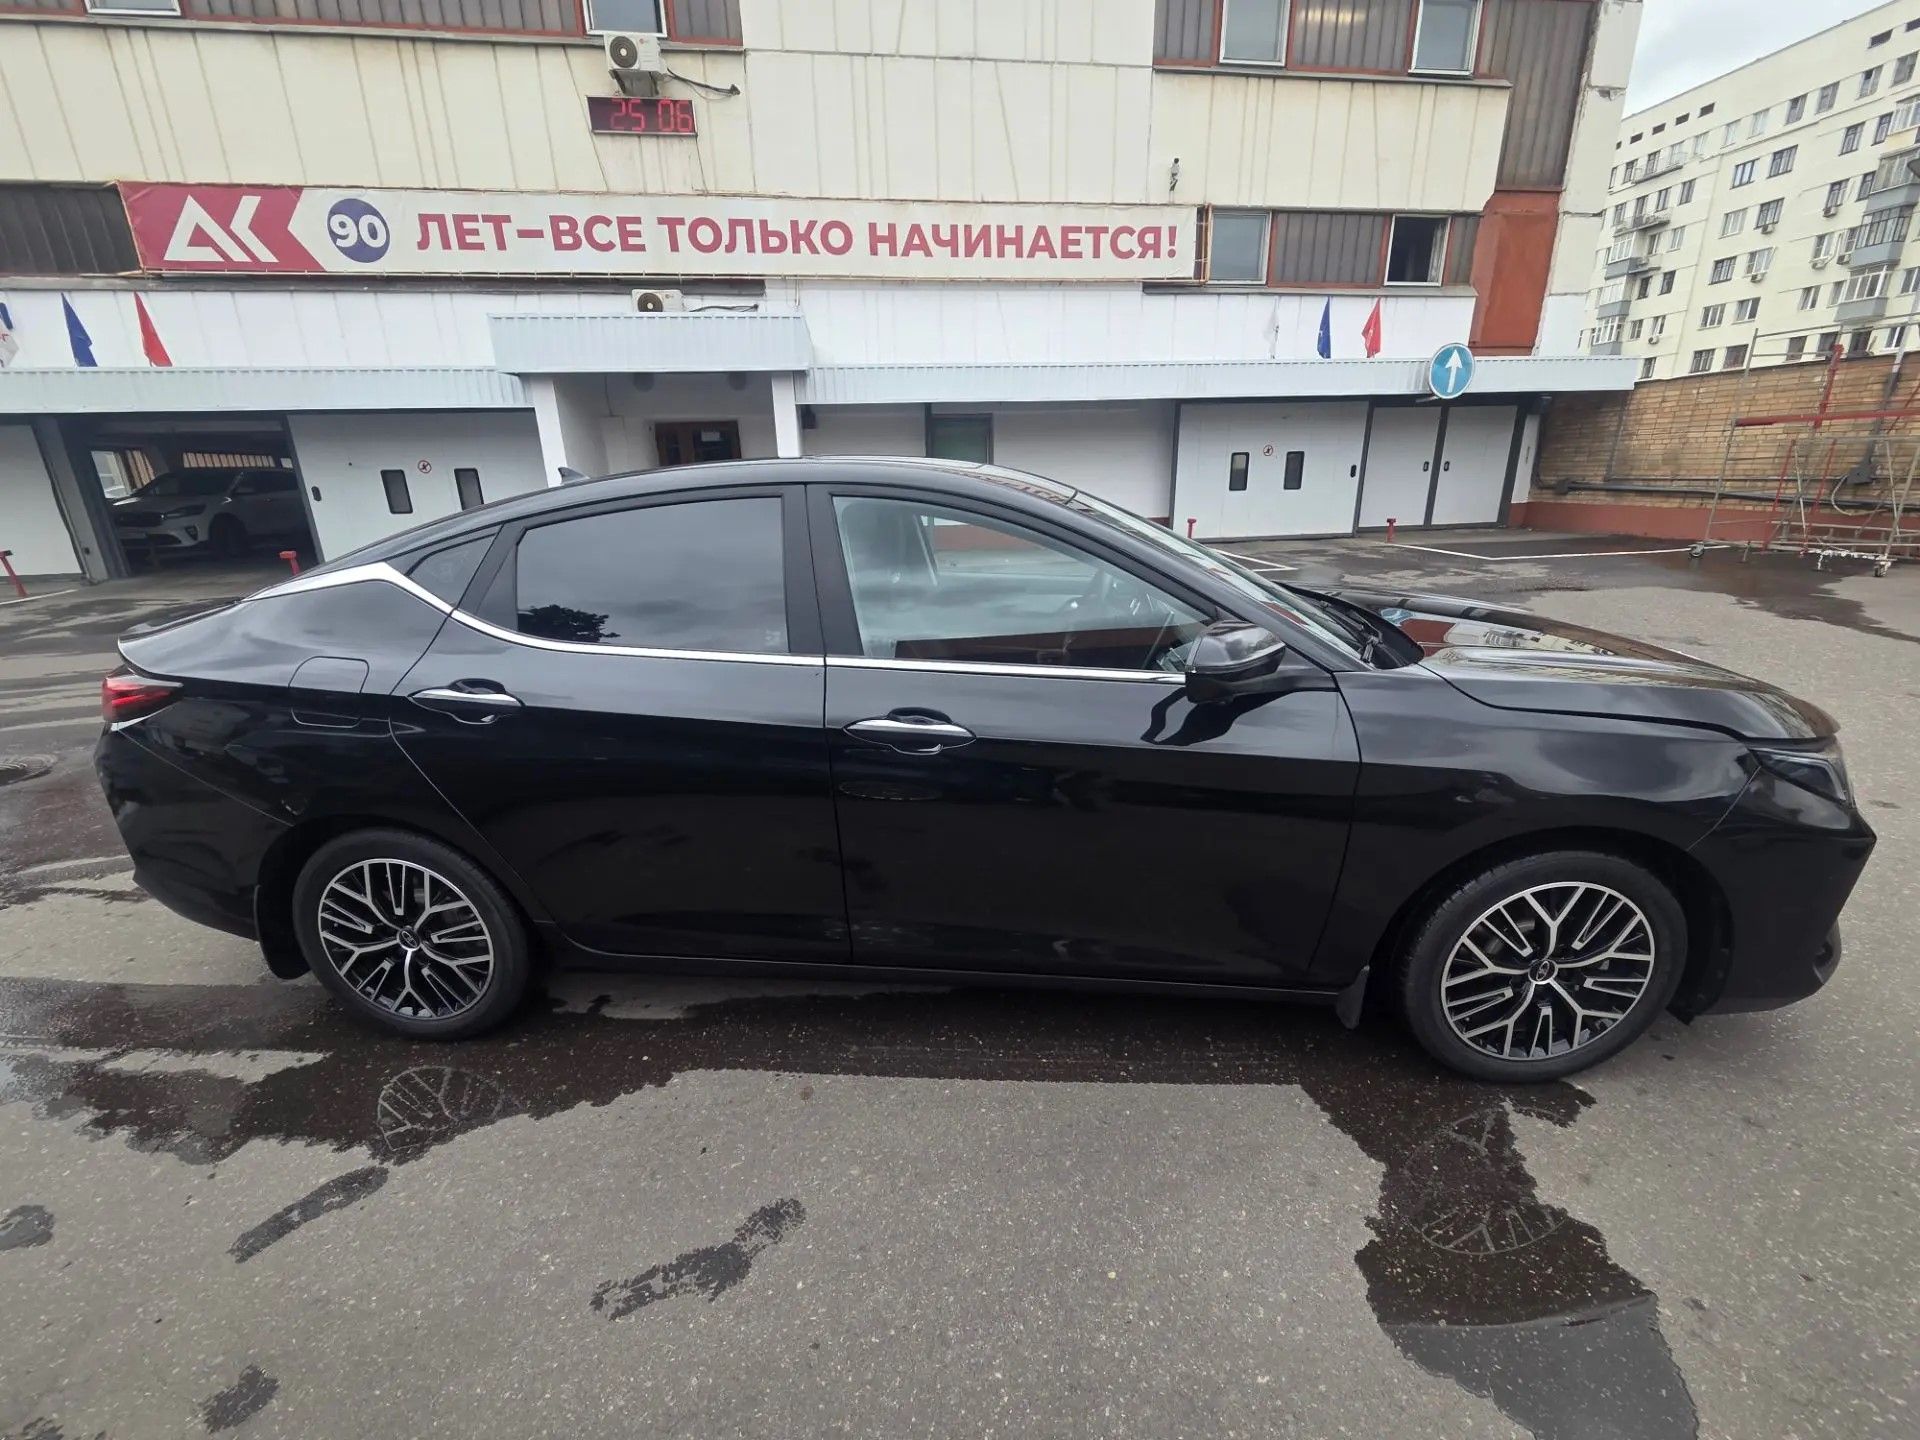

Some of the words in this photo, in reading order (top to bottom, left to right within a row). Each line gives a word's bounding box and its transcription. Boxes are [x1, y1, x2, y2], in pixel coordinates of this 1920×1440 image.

[611, 98, 645, 131] 25
[658, 98, 692, 132] 06
[329, 213, 388, 249] 90
[657, 216, 853, 256] ТОЛЬКО
[868, 222, 1178, 259] НАЧИНАЕТСЯ!
